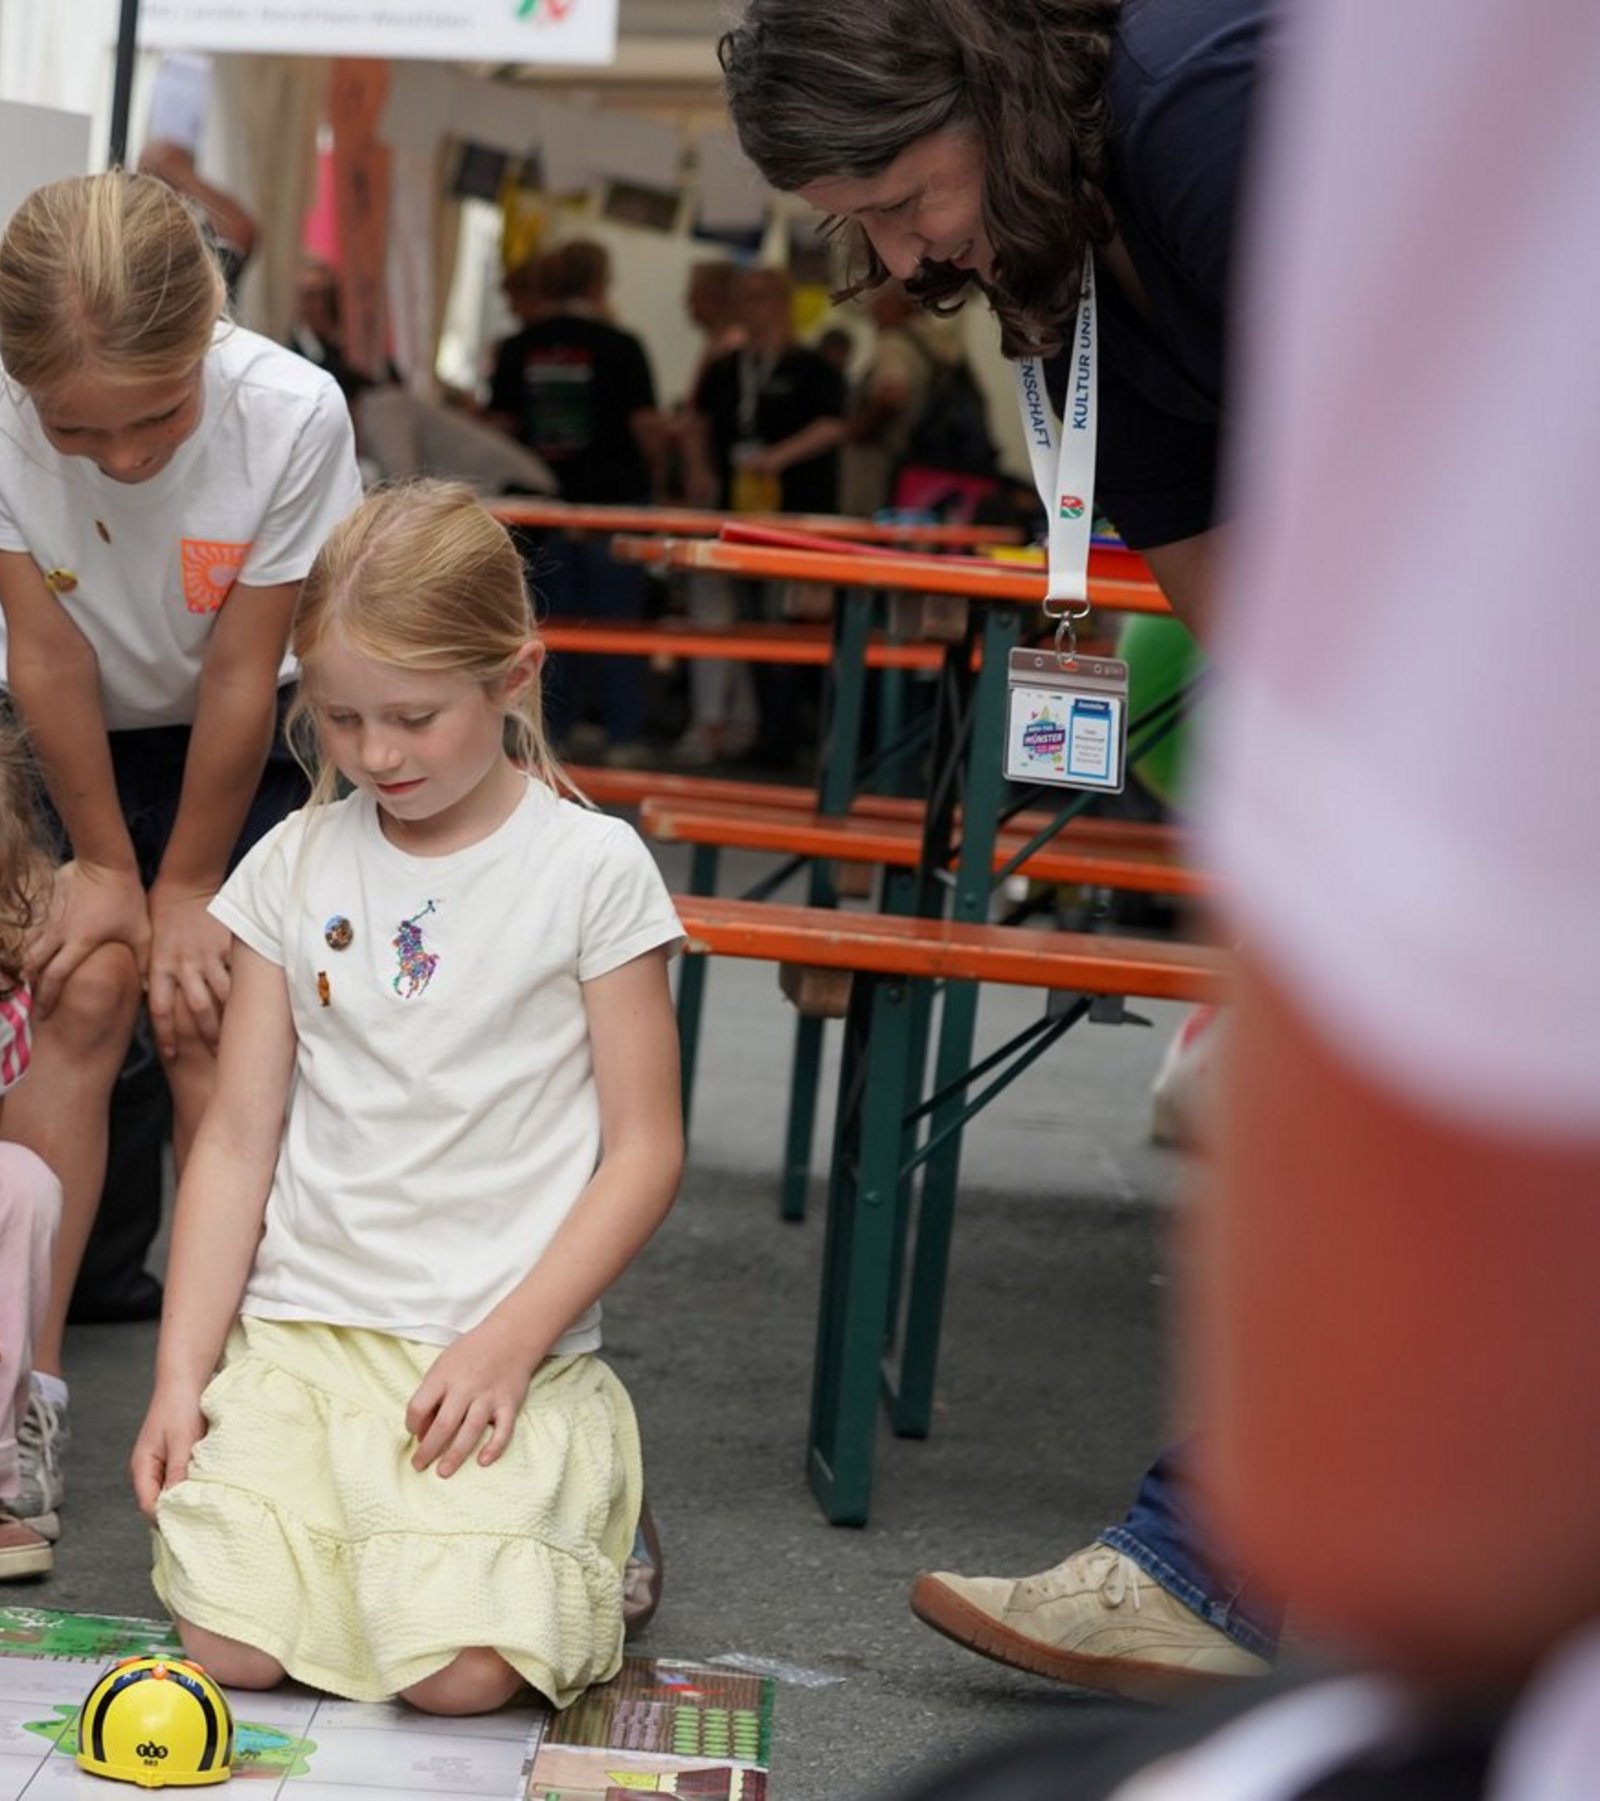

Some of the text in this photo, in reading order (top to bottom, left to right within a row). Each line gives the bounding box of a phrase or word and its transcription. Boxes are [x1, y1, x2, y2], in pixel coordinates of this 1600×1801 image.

[1080, 307, 1092, 349] UND
[1021, 356, 1052, 449] ENSCHAFT
[1073, 355, 1091, 430] KULTUR
[1024, 731, 1062, 744] MÜNSTER
